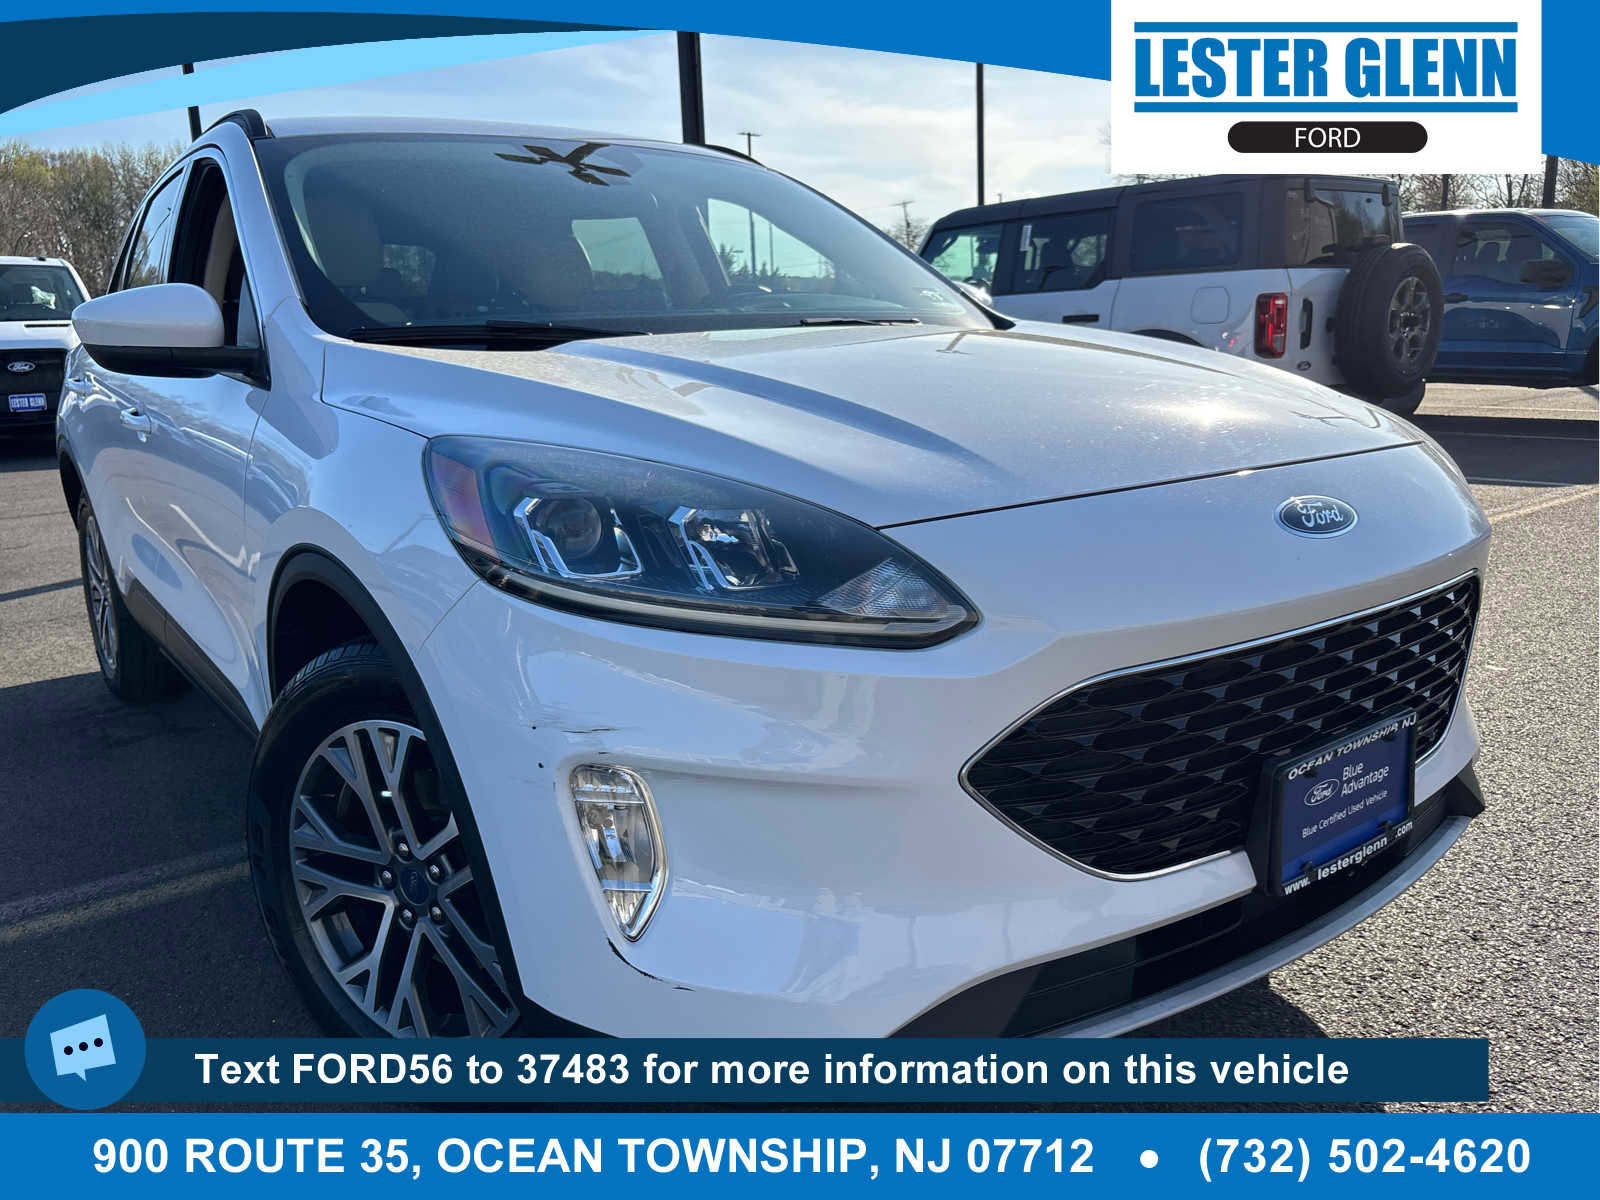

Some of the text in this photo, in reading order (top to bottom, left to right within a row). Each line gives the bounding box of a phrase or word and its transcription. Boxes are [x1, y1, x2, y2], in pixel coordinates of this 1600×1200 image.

[1296, 501, 1344, 528] Ford
[1401, 714, 1417, 729] NJ
[1341, 766, 1390, 797] Advantage
[1342, 762, 1364, 781] Blue
[1310, 782, 1334, 803] Ford
[1302, 824, 1318, 839] Blue
[1318, 808, 1347, 830] Certified
[1347, 800, 1364, 815] Used
[1284, 821, 1413, 896] www. lesterglenn .com
